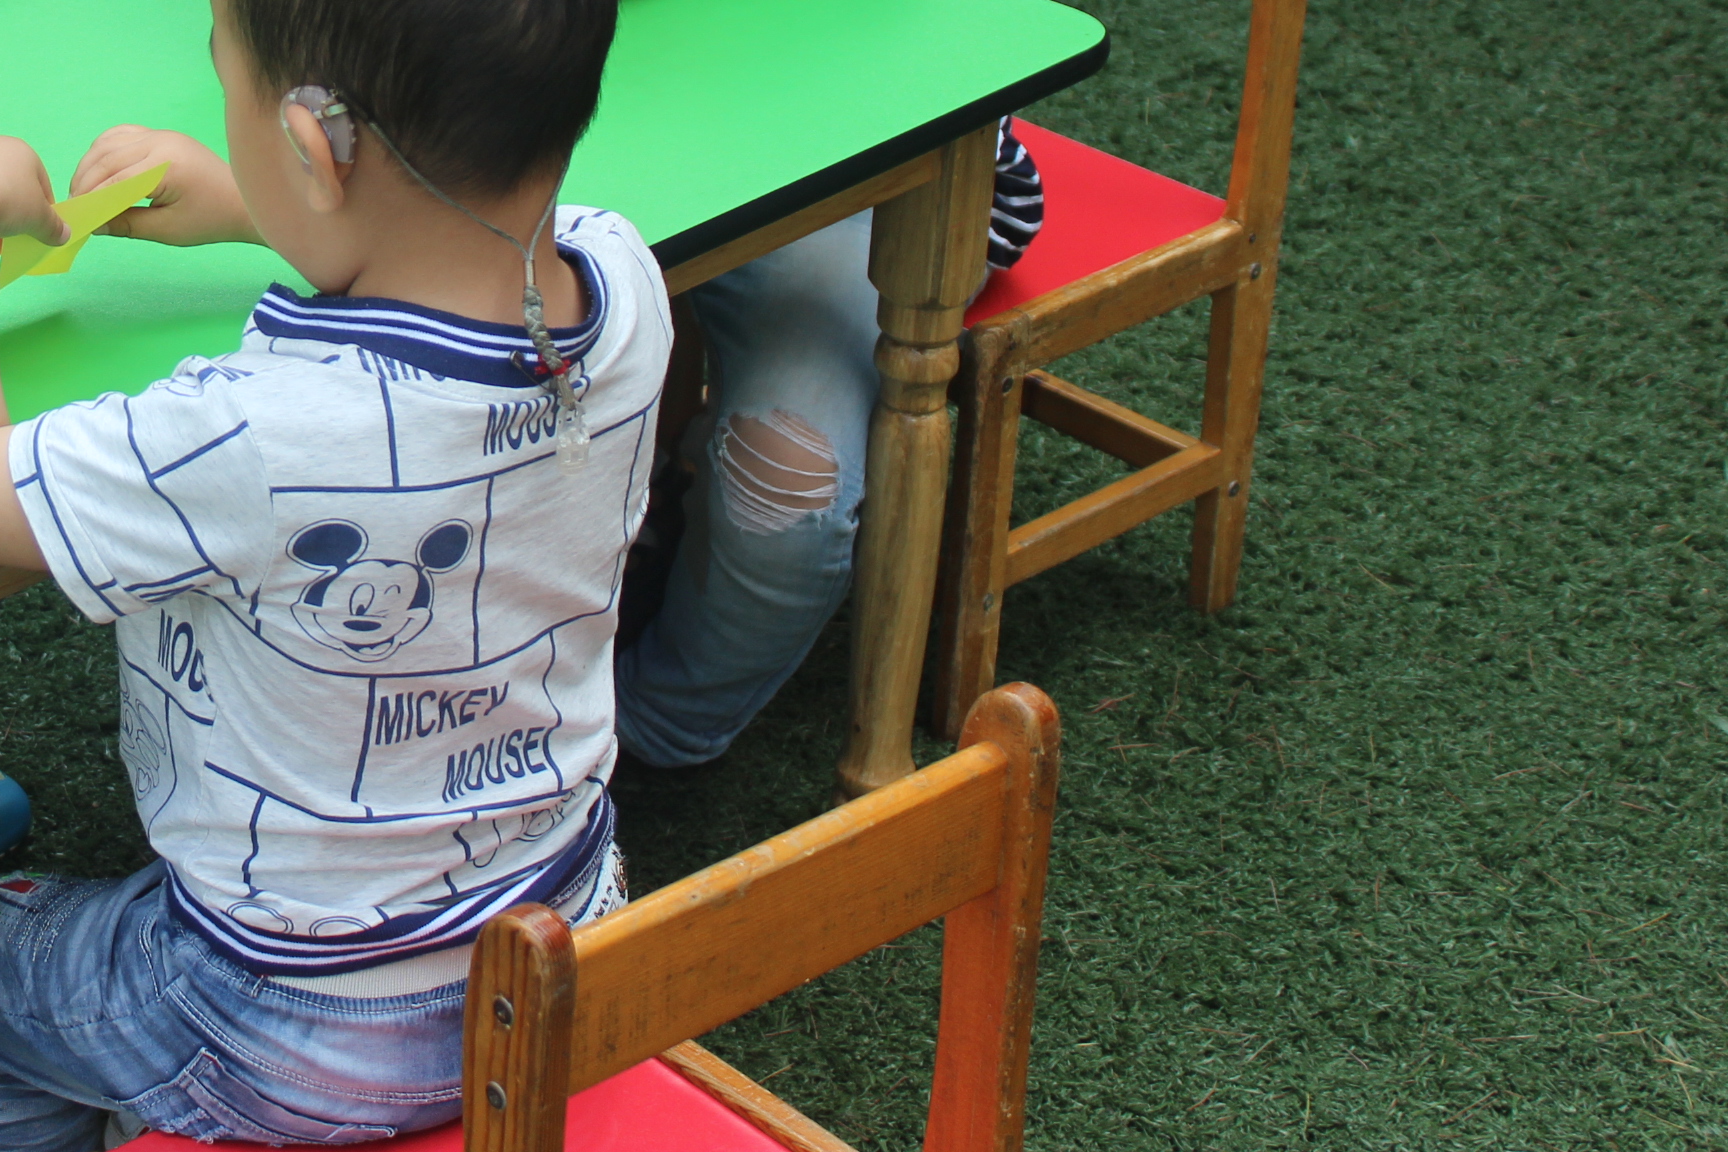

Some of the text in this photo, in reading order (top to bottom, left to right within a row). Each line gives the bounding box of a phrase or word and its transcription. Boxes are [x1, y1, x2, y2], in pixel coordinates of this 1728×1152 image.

[482, 394, 566, 457] MOUS
[374, 680, 510, 747] MICKEY
[441, 726, 549, 804] MOUSE
